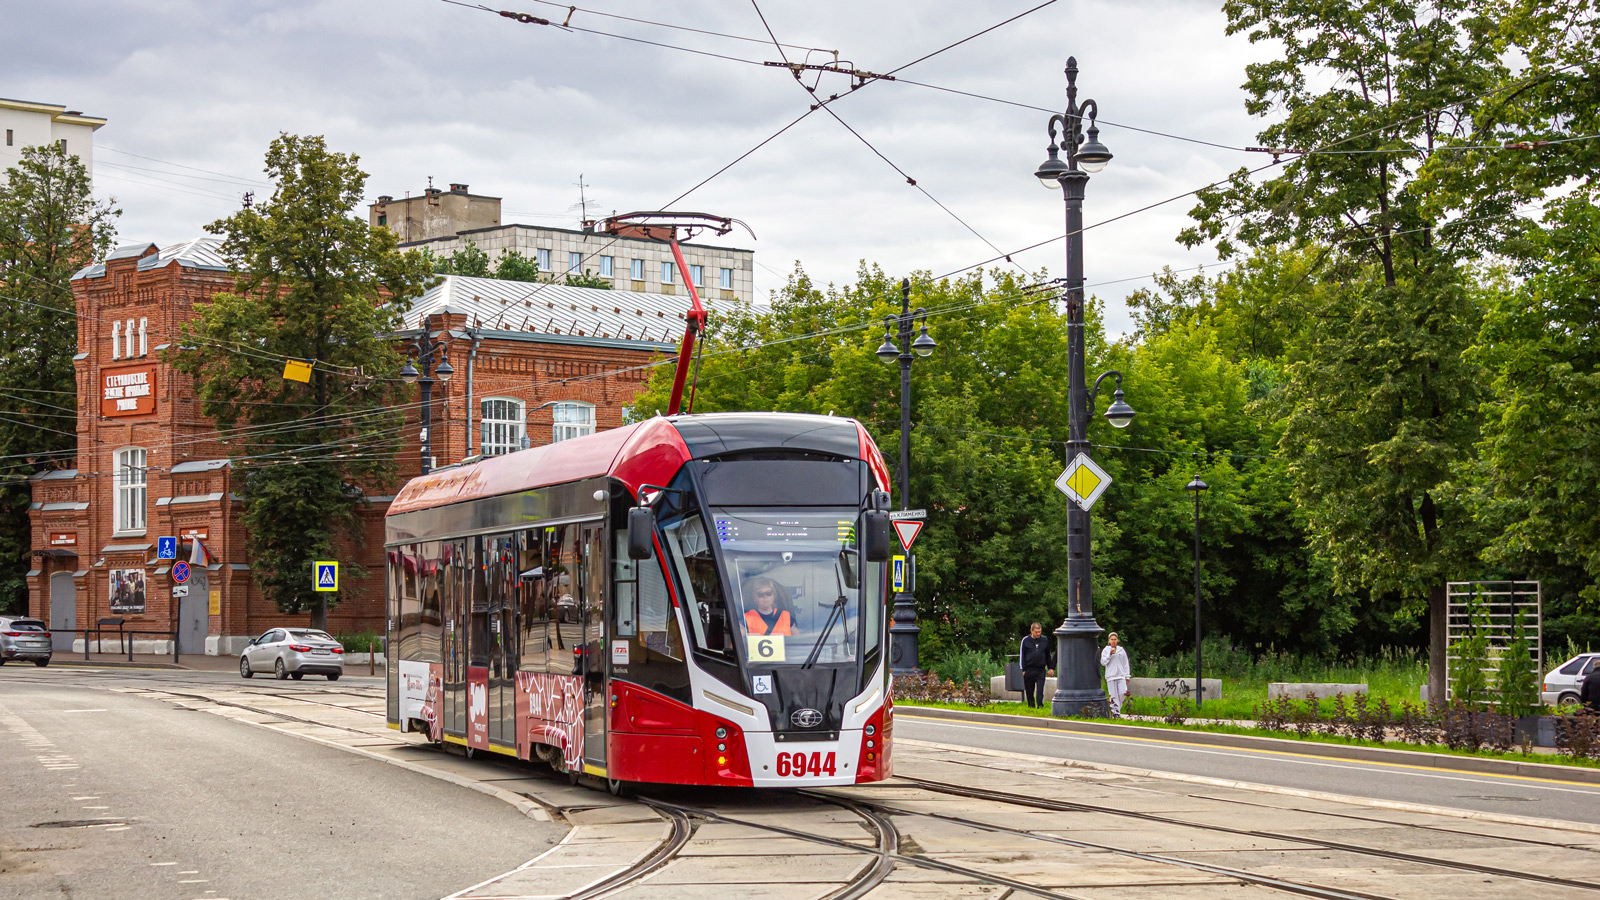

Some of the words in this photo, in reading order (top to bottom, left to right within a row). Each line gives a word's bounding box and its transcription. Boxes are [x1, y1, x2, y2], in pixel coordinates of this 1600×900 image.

[758, 639, 774, 657] 6
[529, 693, 542, 715] 6944
[776, 752, 837, 777] 6944
